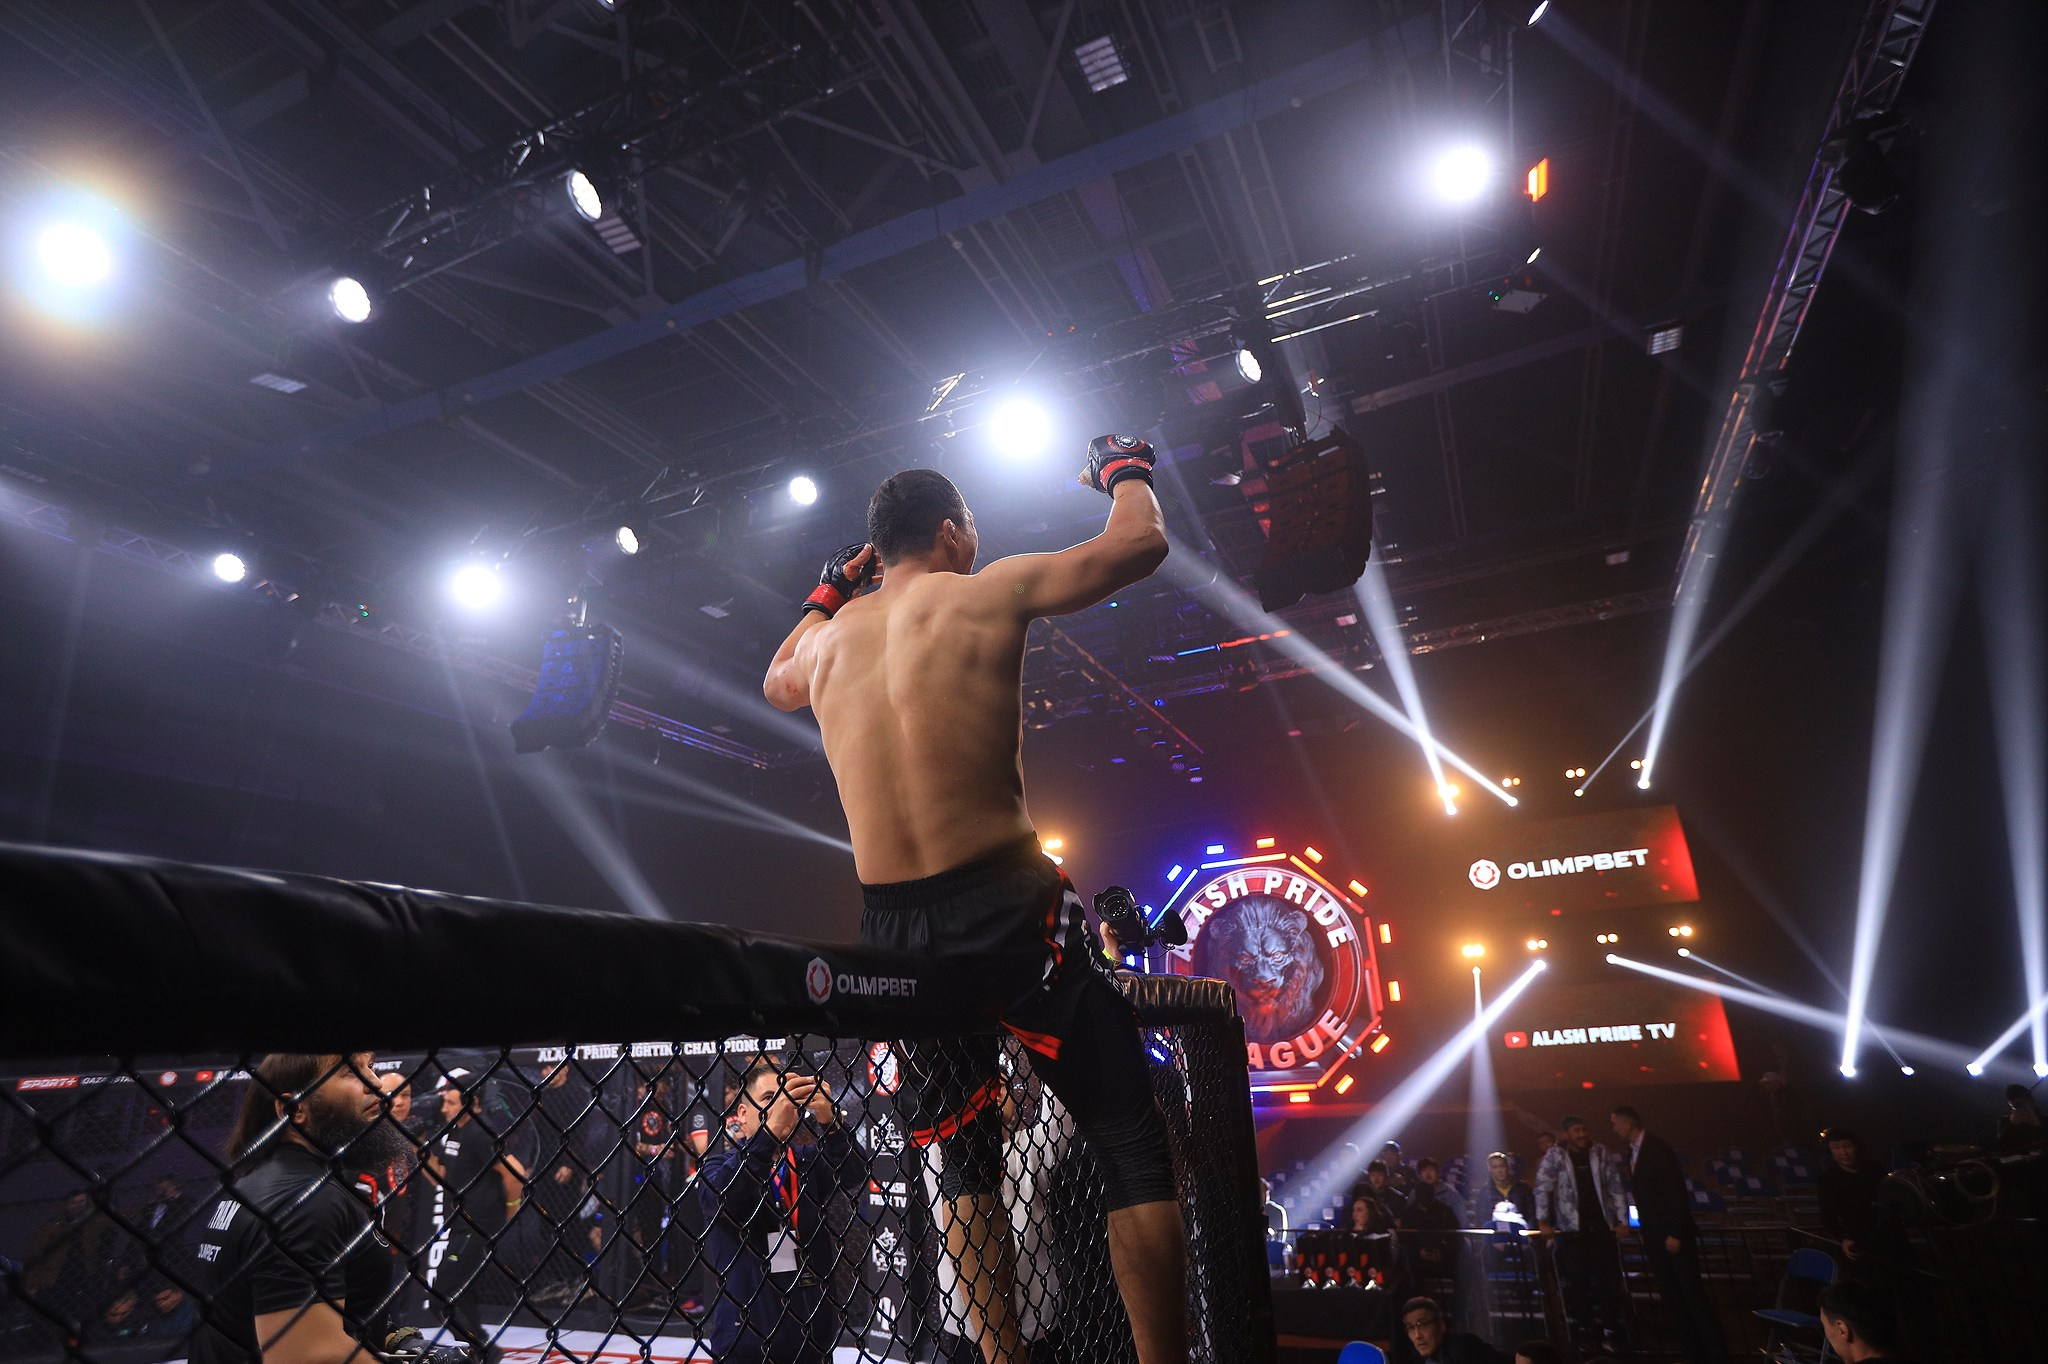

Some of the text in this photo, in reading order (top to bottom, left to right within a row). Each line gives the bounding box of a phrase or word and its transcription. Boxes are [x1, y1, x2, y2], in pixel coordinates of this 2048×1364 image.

[1507, 848, 1648, 880] OLIMPBET
[1264, 872, 1354, 949] PRIDE
[836, 973, 918, 997] OLIMPBET
[1249, 1009, 1348, 1070] AGUE
[1532, 1022, 1676, 1047] ALASH PRIDE TV
[537, 1046, 579, 1062] ALA
[582, 1044, 619, 1060] PRIDE
[630, 1041, 682, 1058] IGHTIN
[19, 1078, 77, 1090] SPORT+
[893, 1196, 907, 1208] TV
